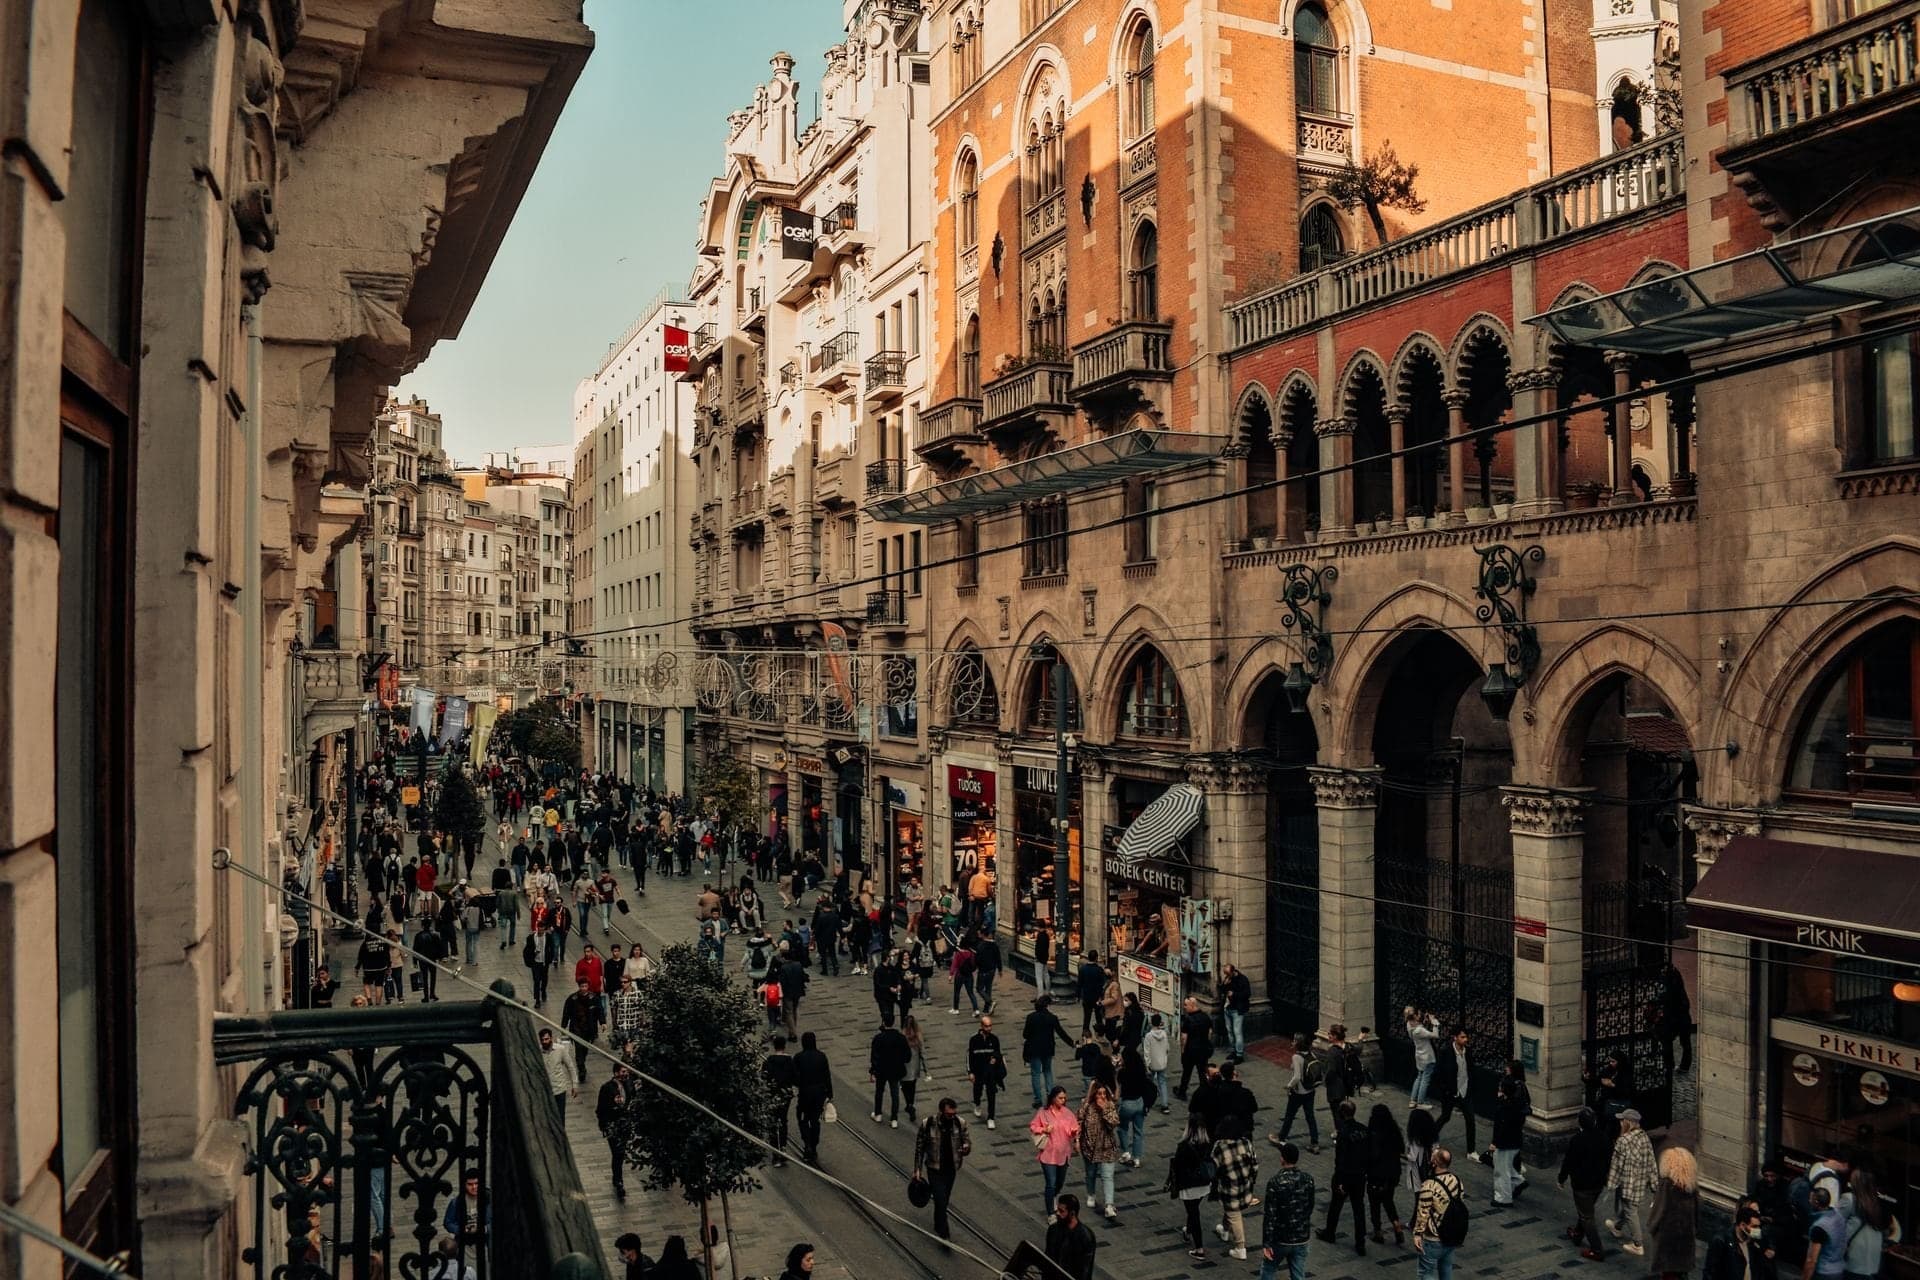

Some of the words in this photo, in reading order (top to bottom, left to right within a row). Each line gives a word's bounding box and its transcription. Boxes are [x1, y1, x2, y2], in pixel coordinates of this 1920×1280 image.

[784, 226, 813, 239] OGM
[665, 344, 688, 354] OGM
[957, 778, 982, 794] TUDORS
[954, 849, 978, 872] 70
[1143, 868, 1185, 894] CENTER
[1796, 923, 1867, 953] PİKNİK
[1820, 1034, 1901, 1067] PİKNİK
